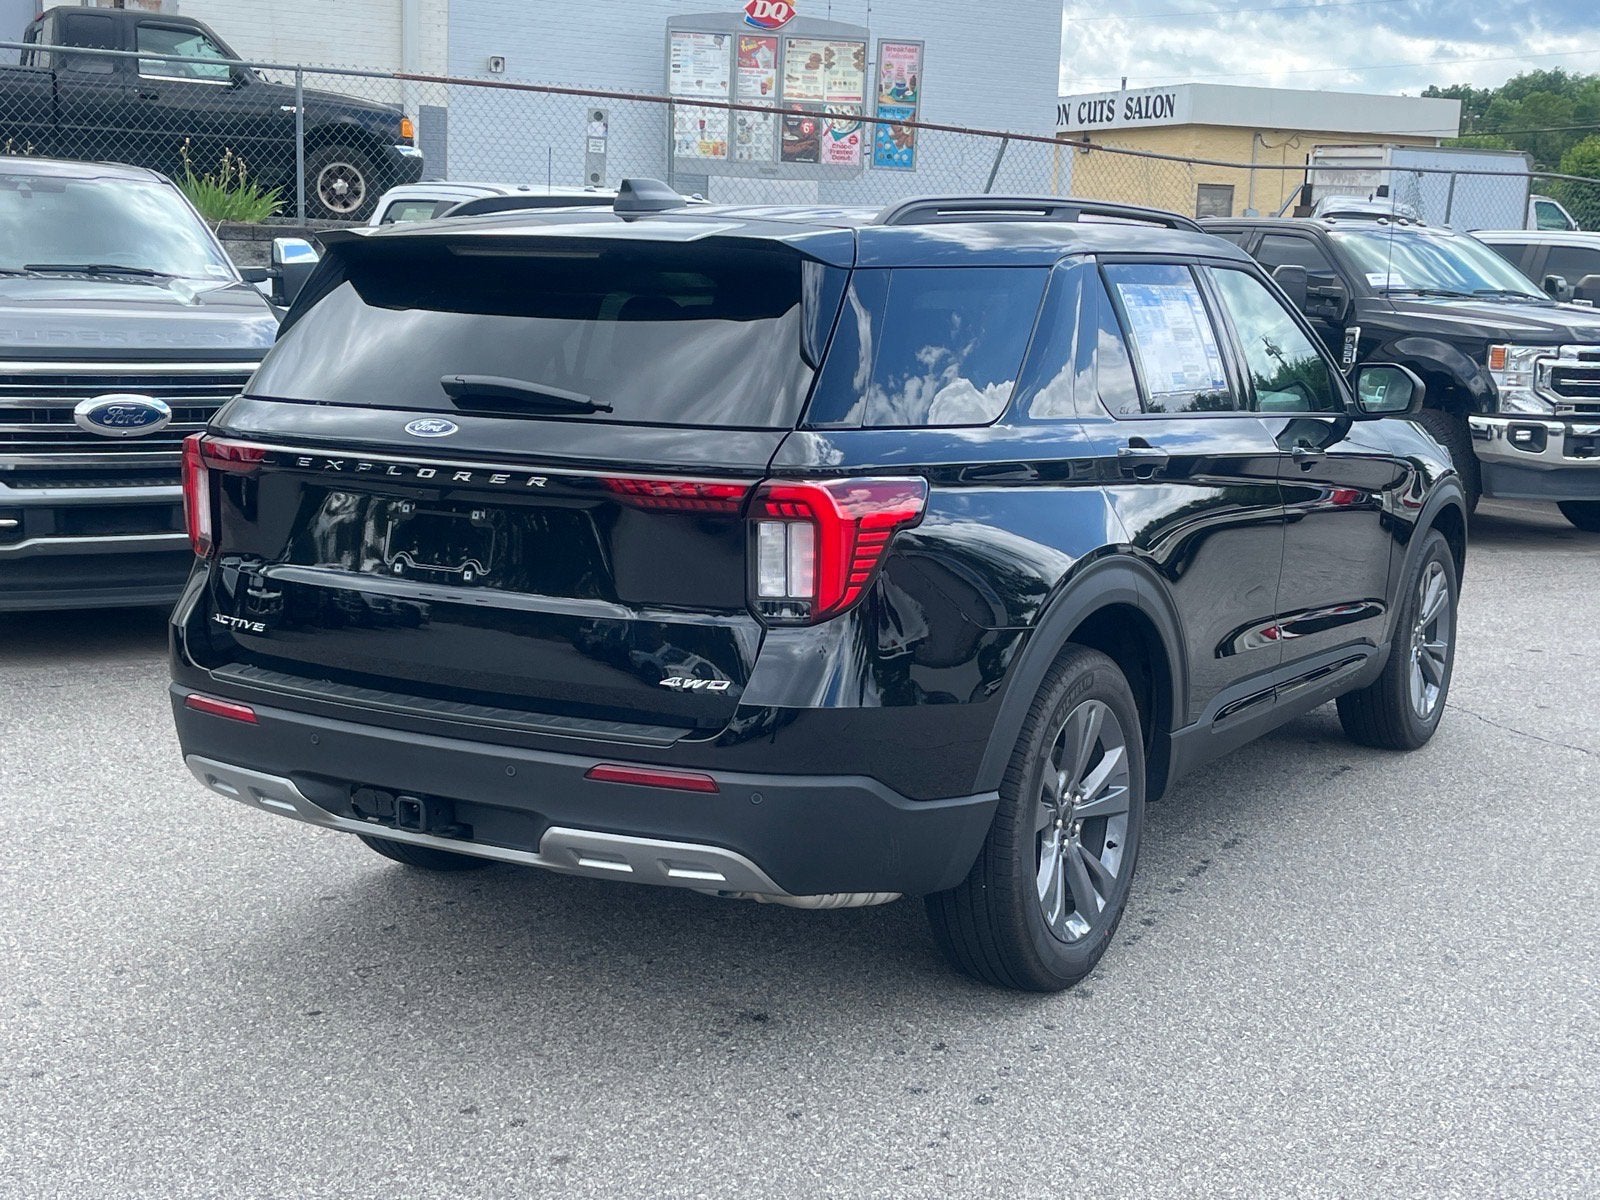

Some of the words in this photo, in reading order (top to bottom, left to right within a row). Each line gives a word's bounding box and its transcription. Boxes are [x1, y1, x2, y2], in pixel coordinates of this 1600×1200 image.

[752, 0, 788, 22] DQ
[885, 45, 918, 54] Breakfast
[1077, 98, 1116, 125] CUTS
[1123, 93, 1176, 121] SALON
[102, 405, 148, 426] Ford
[413, 419, 446, 434] Ford
[295, 456, 550, 489] EXPLORER
[211, 613, 266, 632] ACTIVE
[659, 676, 731, 690] 4WD
